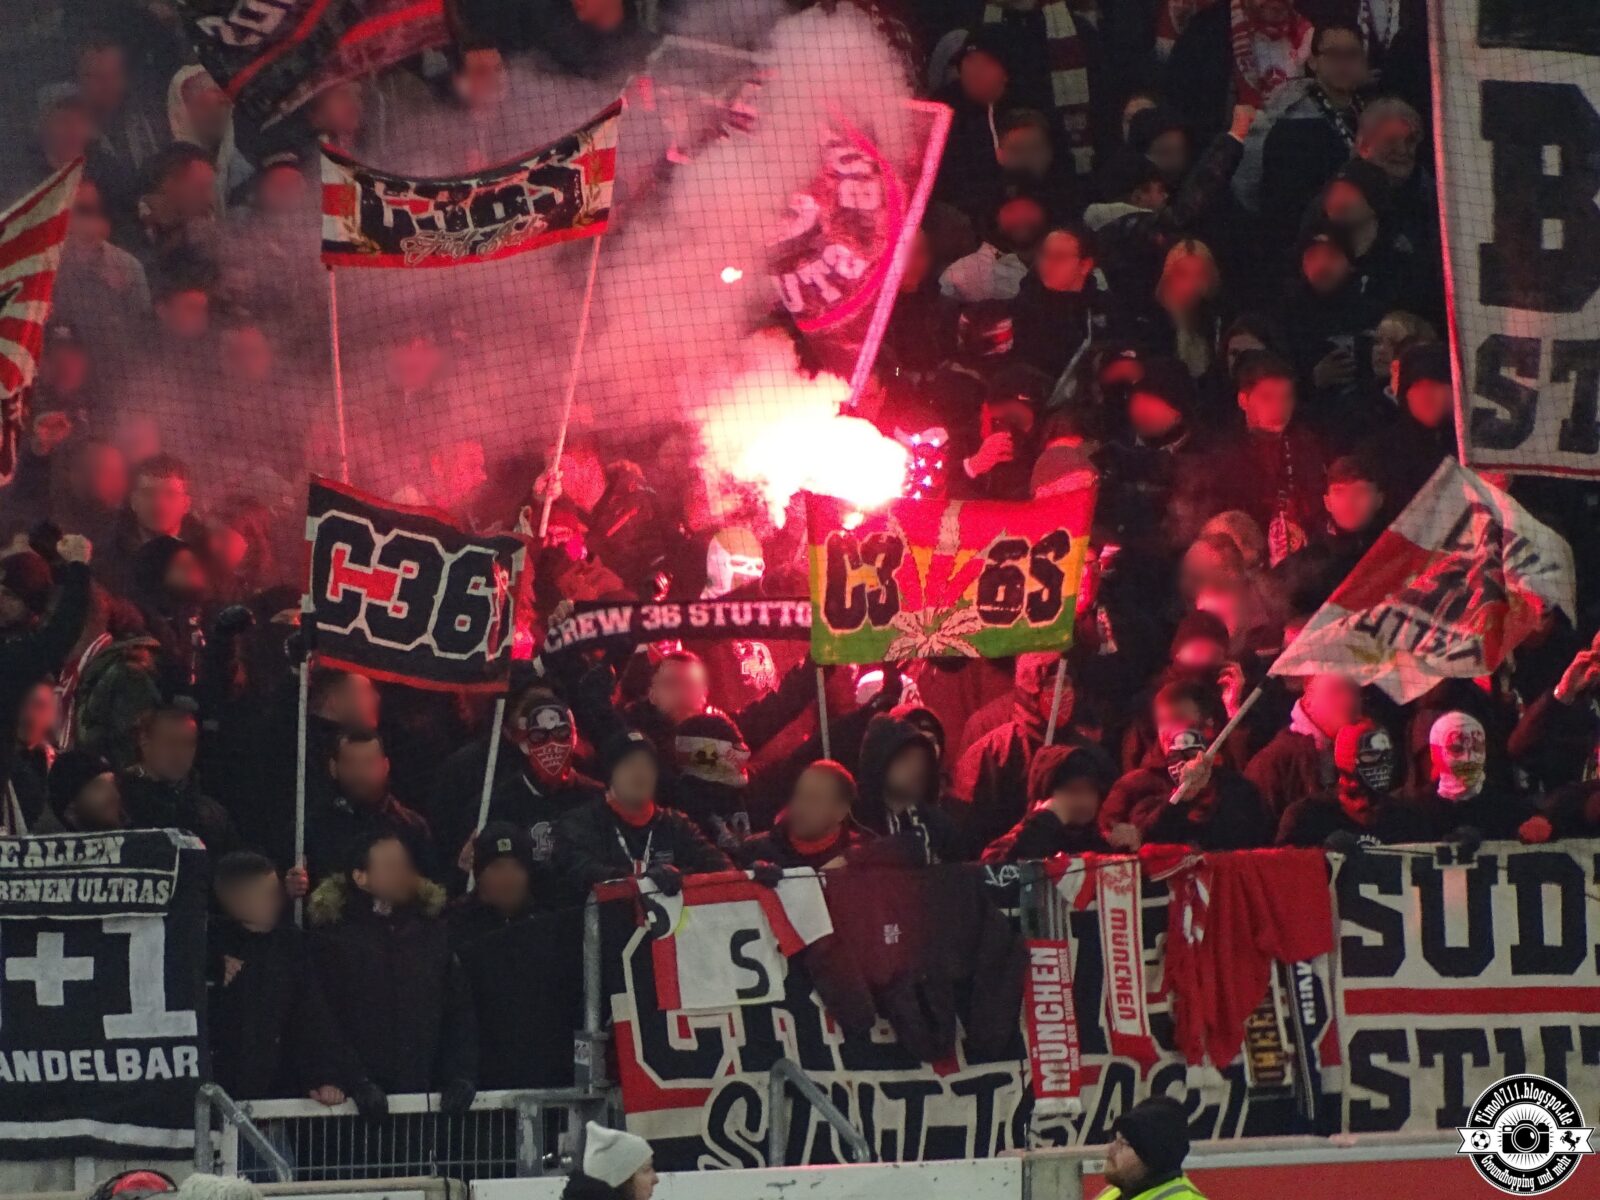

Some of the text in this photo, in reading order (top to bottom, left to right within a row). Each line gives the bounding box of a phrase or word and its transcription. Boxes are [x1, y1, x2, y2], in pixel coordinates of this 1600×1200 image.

[544, 606, 634, 653] CREW
[640, 603, 681, 630] 36
[23, 836, 125, 868] ALLEN
[77, 877, 171, 906] ULTRAS
[1337, 846, 1600, 979] SÜD
[1110, 907, 1137, 1020] MÜNCHEN
[1030, 946, 1071, 1093] MÜNCHEN
